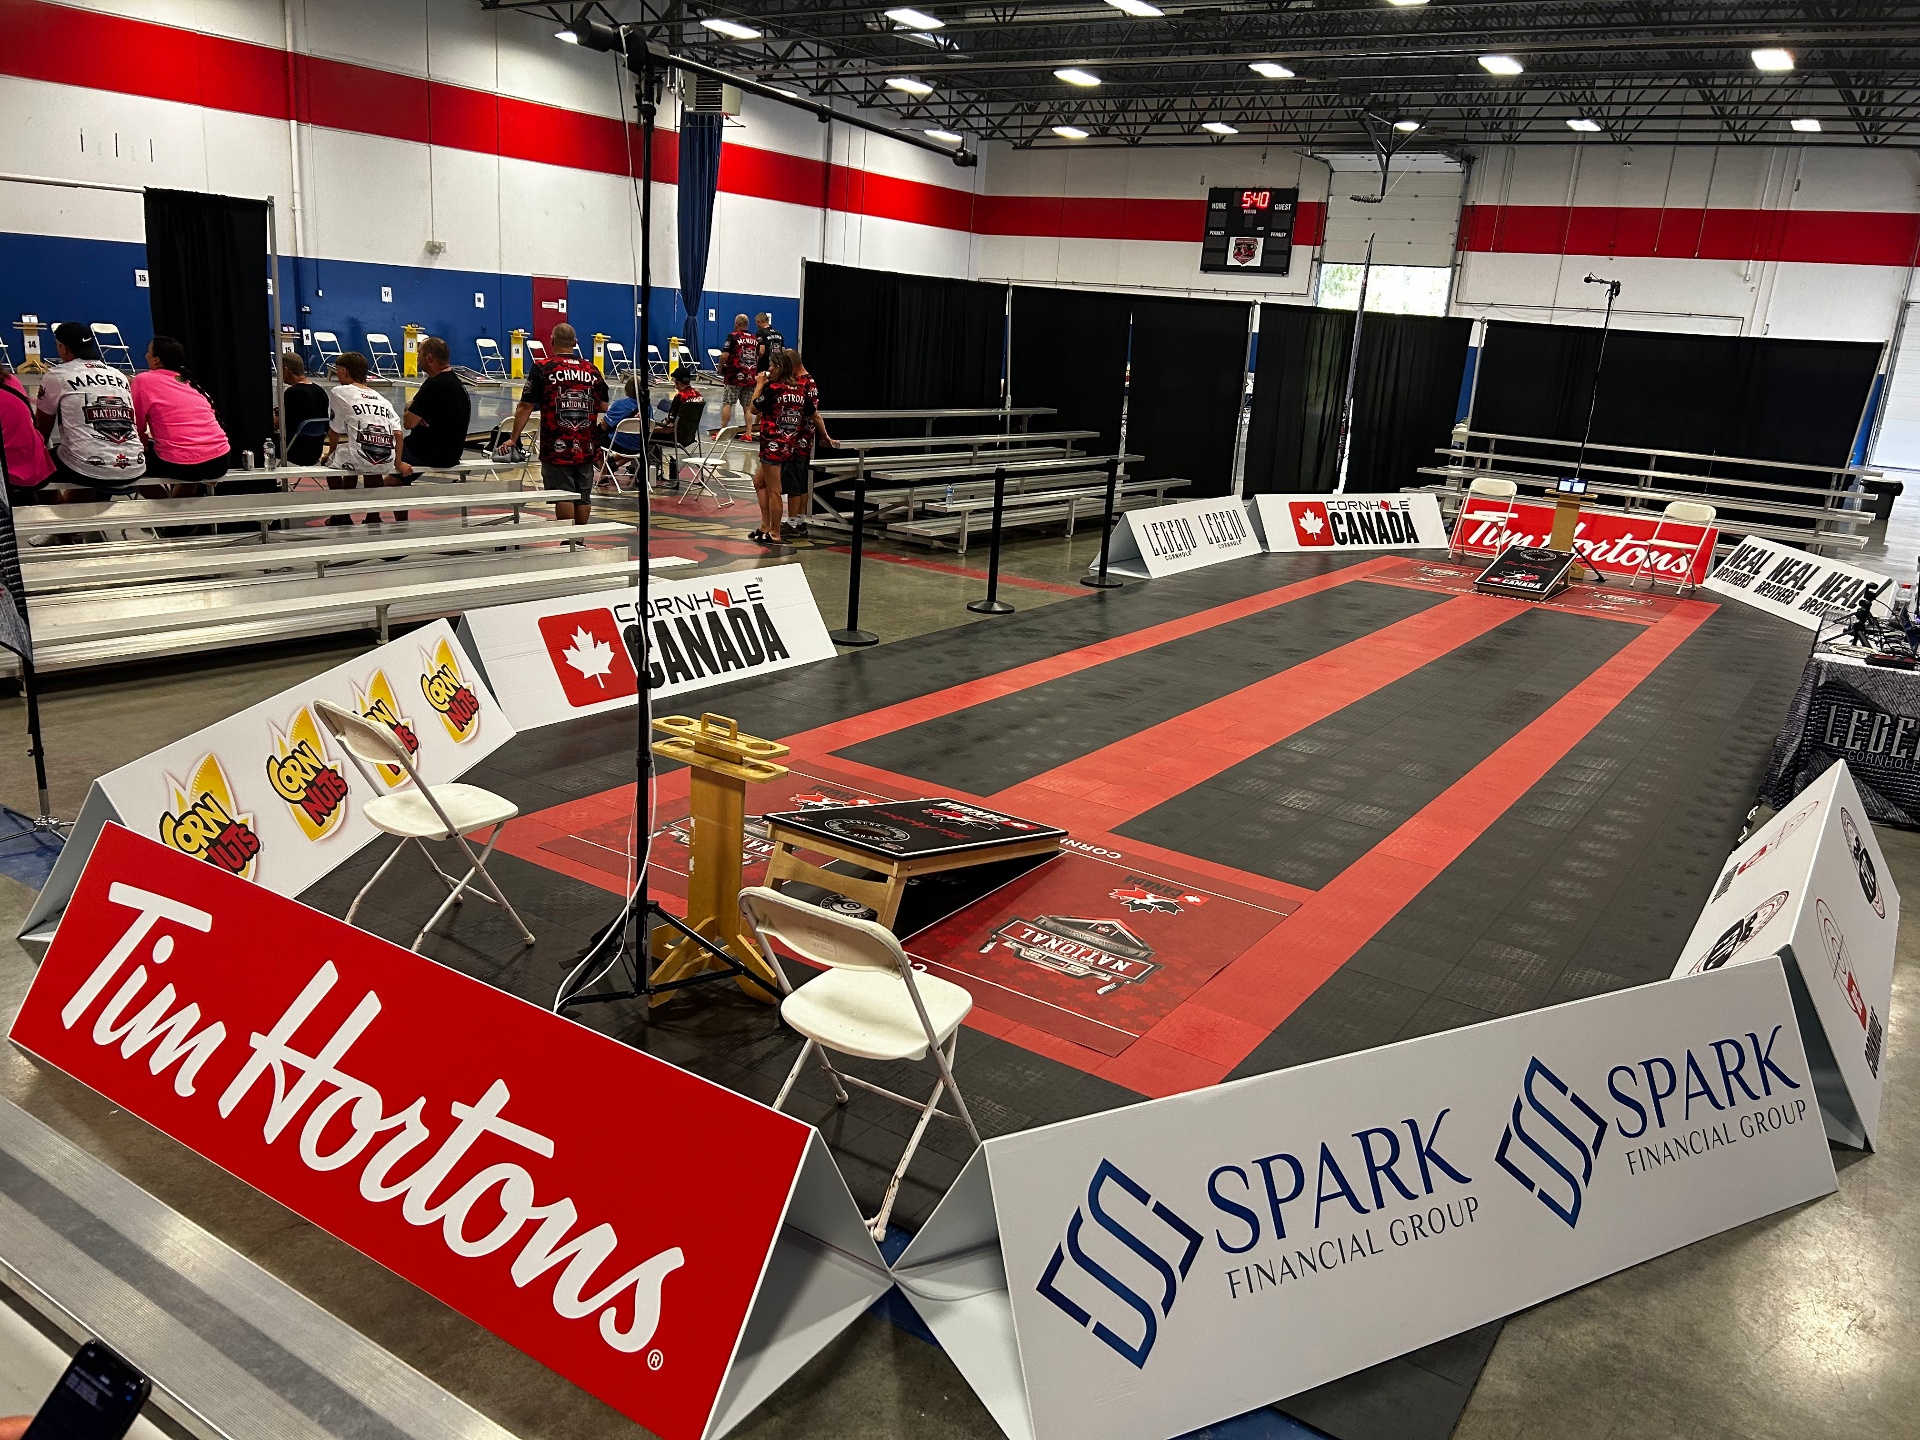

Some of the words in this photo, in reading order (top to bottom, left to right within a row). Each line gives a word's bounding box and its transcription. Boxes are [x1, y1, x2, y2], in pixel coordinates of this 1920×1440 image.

[1211, 202, 1227, 210] HOME
[1241, 191, 1270, 207] 5:40
[1274, 203, 1292, 211] GUEST
[138, 274, 147, 282] 15
[27, 340, 37, 349] 14
[548, 369, 598, 386] SCHMIDT
[92, 409, 131, 419] NATIONAL
[362, 434, 391, 445] NATIONAL
[1329, 511, 1420, 545] CANADA
[1467, 509, 1534, 548] Tim
[1164, 550, 1192, 562] CORNHOLE
[1724, 543, 1776, 576] NEAL
[1765, 556, 1822, 592] NEAL
[1501, 578, 1543, 589] CANADA
[1712, 565, 1756, 590] BROTHERS
[1753, 580, 1800, 606] BROTHERS
[622, 602, 791, 689] CANADA
[420, 662, 463, 713] CORN
[447, 685, 481, 732] NUTS
[266, 738, 327, 803] CORN
[1847, 750, 1920, 772] CORNHOLE
[300, 762, 349, 827] NUTS
[159, 790, 234, 860] CORN
[1124, 874, 1184, 898] CANADA
[1018, 927, 1133, 972] NATIONAL
[1606, 1025, 1801, 1141] SPARK
[61, 881, 226, 1099] Tim
[217, 959, 685, 1354] Hortons
[1624, 1120, 1738, 1177] FINANCIAL
[1738, 1099, 1807, 1144] GROUP
[1206, 1107, 1473, 1255] SPARK
[1224, 1230, 1384, 1300] FINANCIAL
[1389, 1194, 1480, 1248] GROUP
